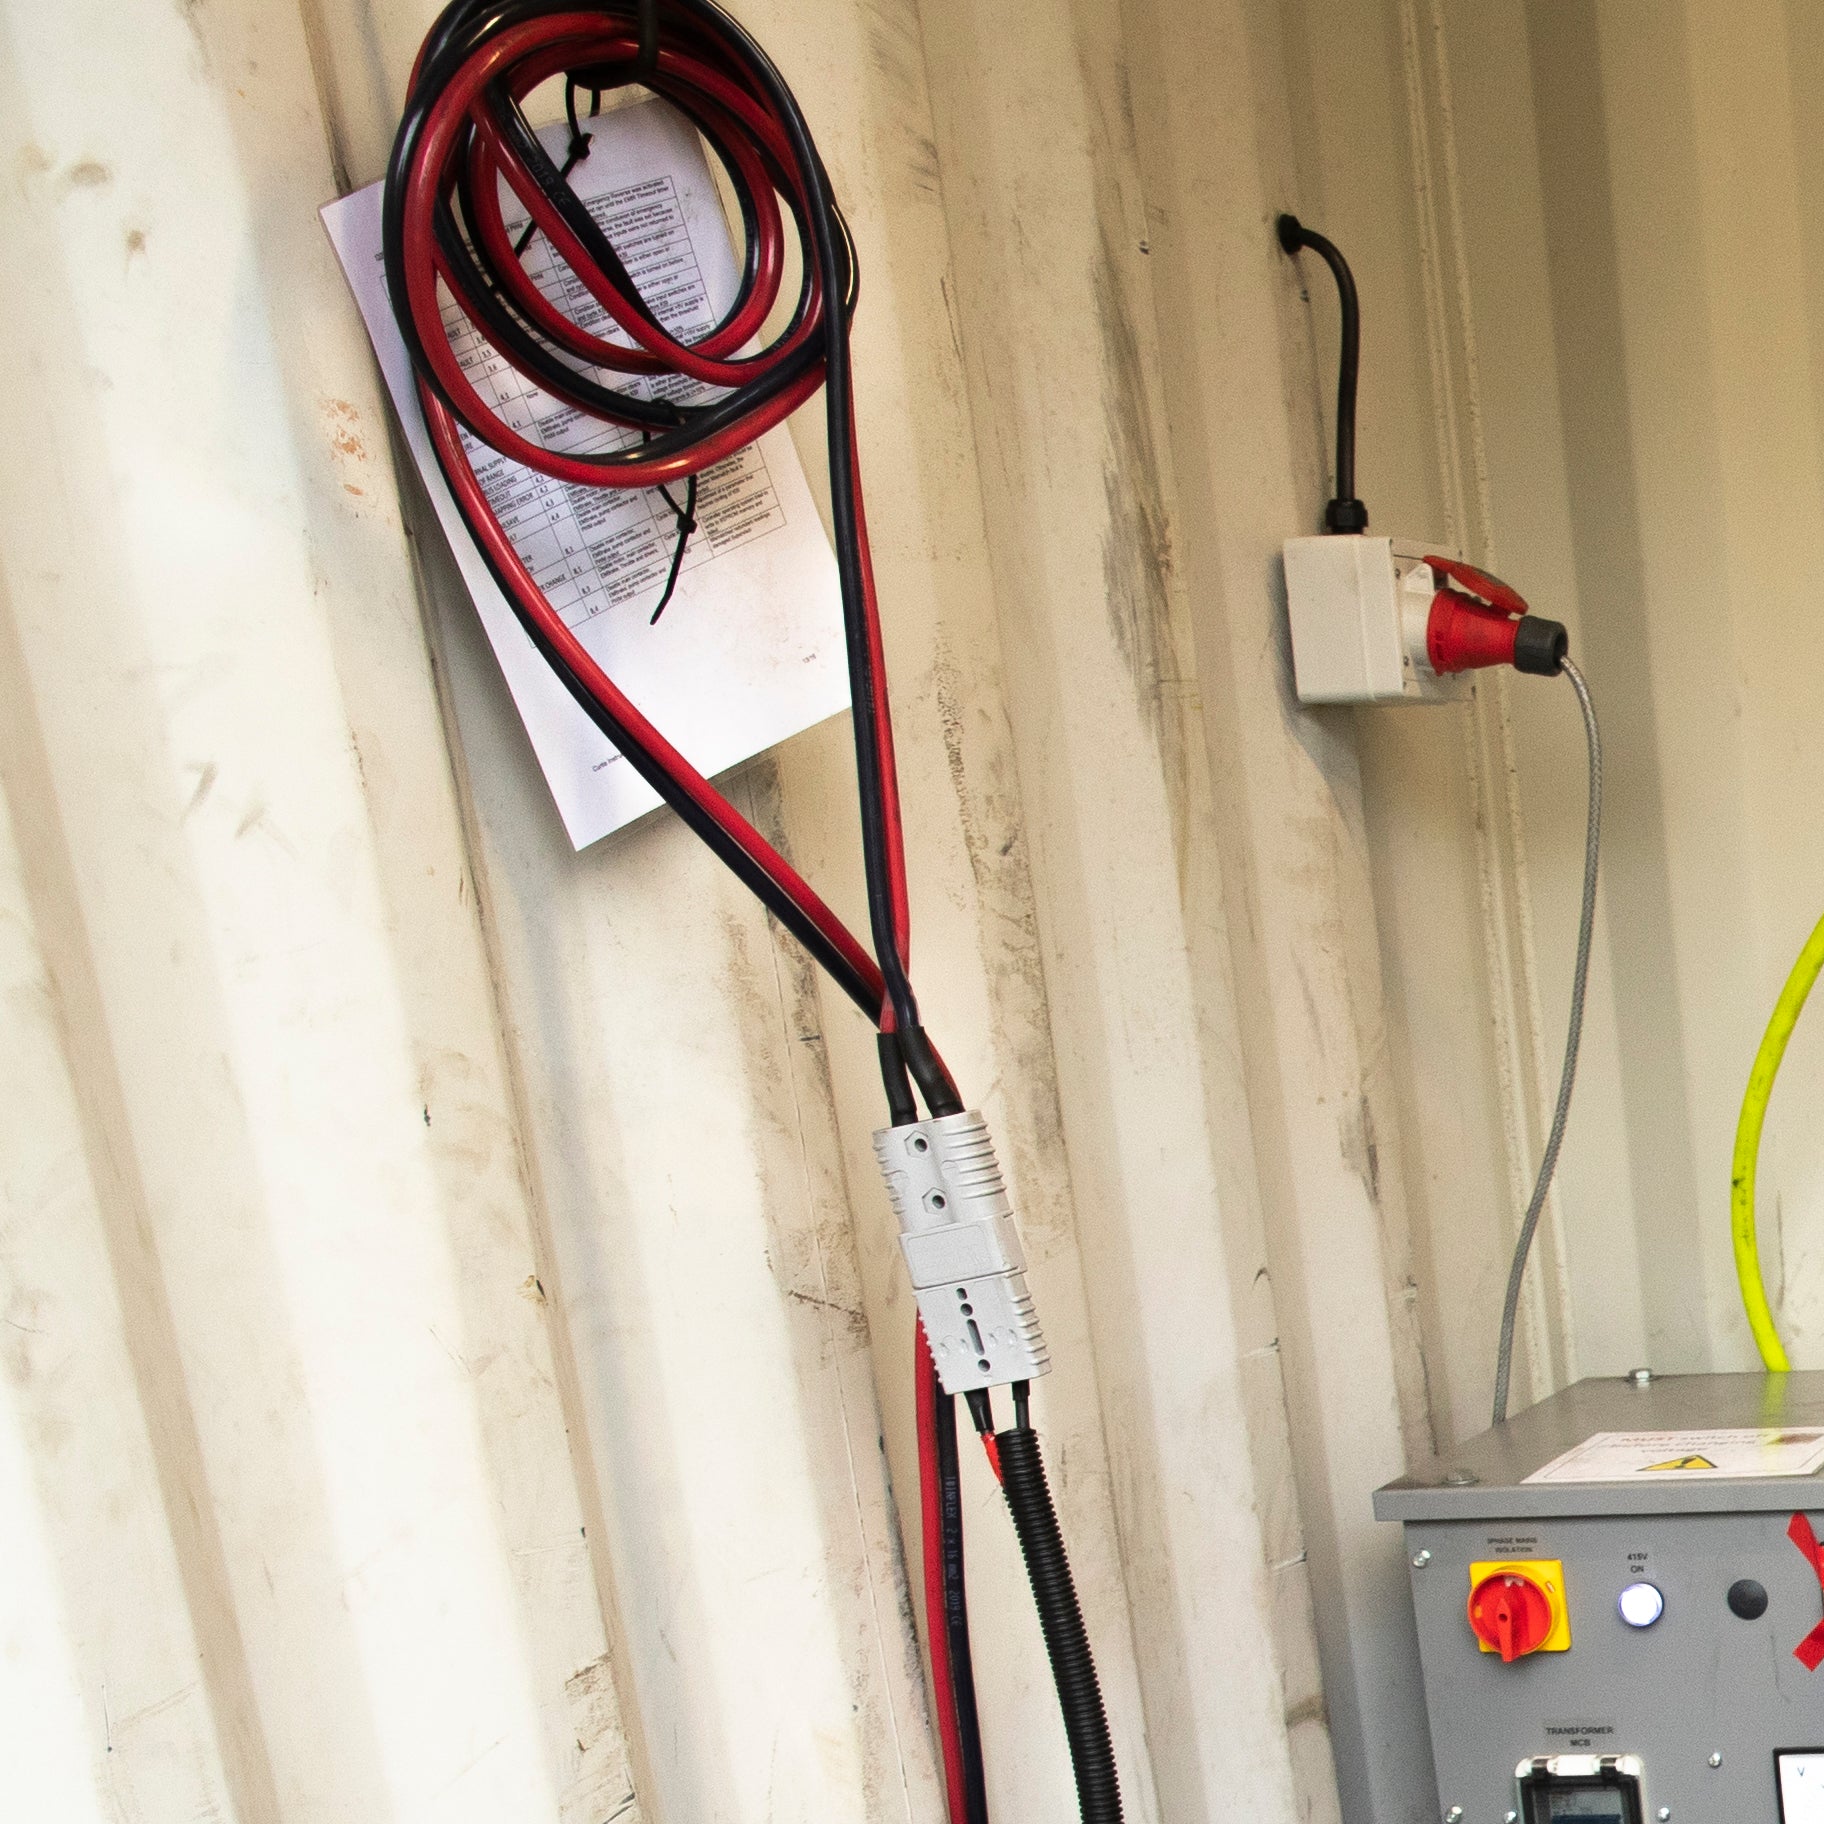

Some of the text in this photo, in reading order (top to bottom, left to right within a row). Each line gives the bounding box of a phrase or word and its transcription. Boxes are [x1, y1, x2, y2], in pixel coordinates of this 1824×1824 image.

[1630, 1565, 1644, 1573] ON
[948, 1589, 960, 1610] 2019
[1797, 1768, 1805, 1776] V
